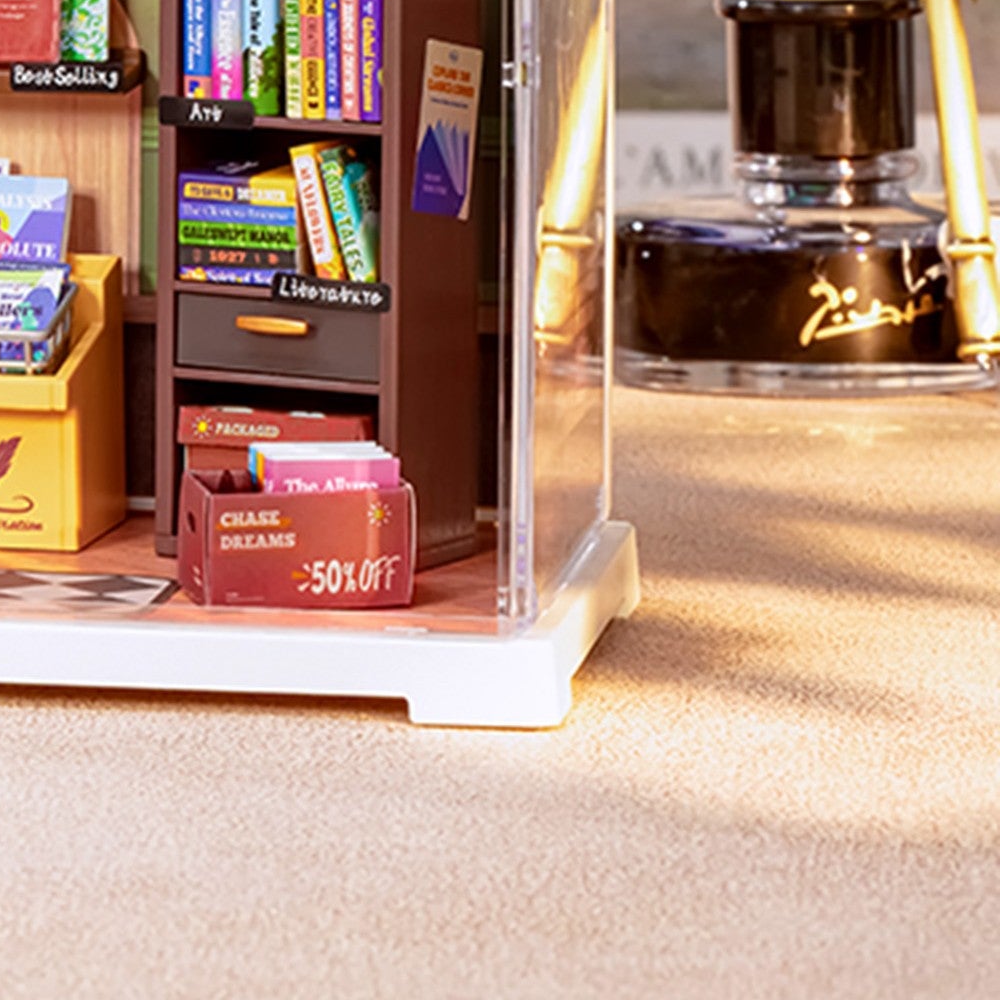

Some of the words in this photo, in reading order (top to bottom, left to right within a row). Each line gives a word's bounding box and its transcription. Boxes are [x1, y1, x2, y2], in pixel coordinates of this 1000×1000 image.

[250, 10, 262, 32] Tale
[250, 33, 263, 47] of
[189, 102, 223, 122] Art
[321, 160, 348, 213] FAIRY
[338, 216, 364, 272] TALES
[215, 423, 282, 438] PACKAGED
[285, 479, 318, 493] The
[220, 510, 281, 527] CHASE
[220, 533, 297, 550] DREAMS
